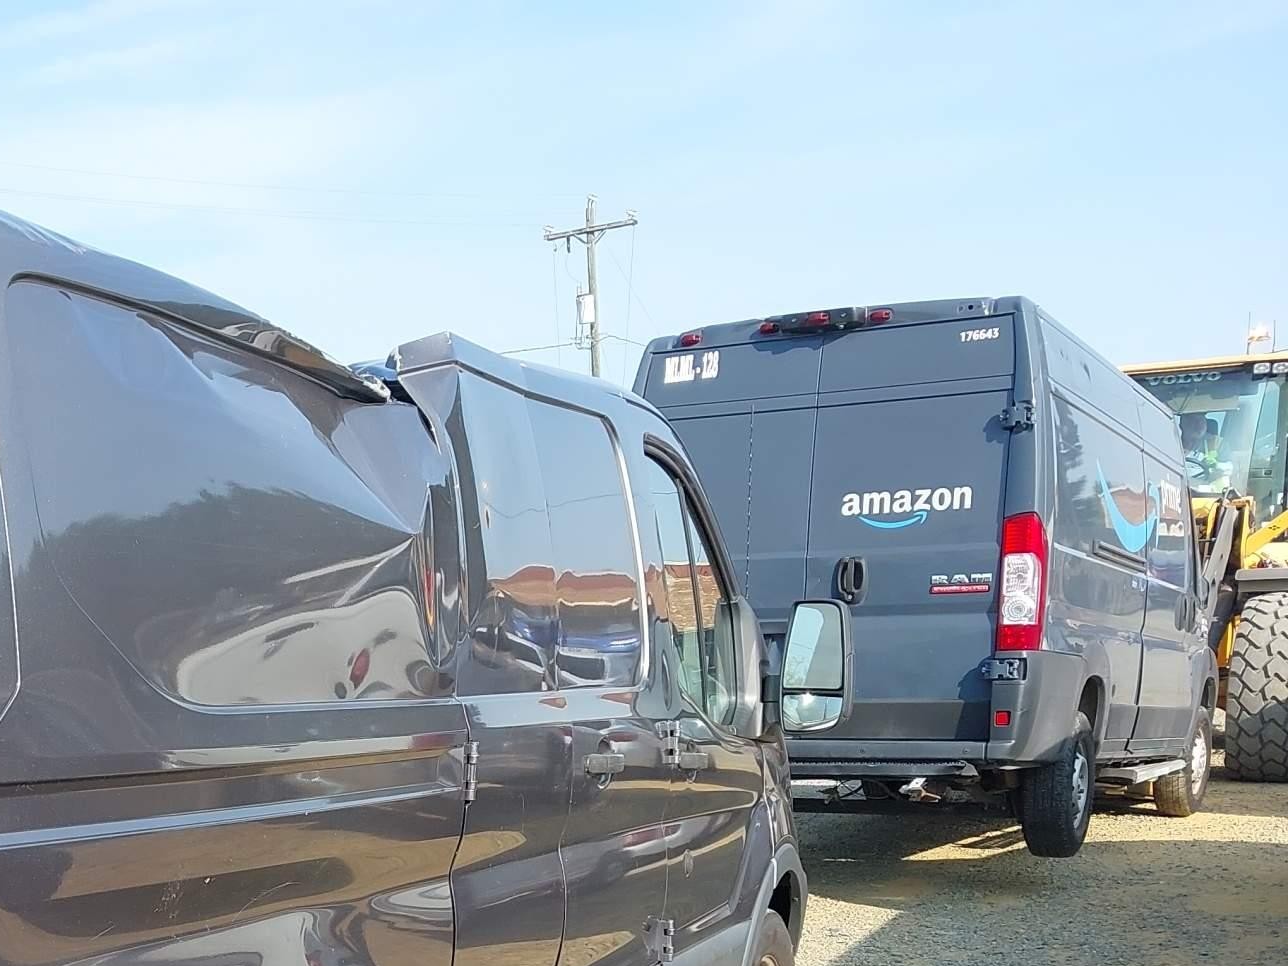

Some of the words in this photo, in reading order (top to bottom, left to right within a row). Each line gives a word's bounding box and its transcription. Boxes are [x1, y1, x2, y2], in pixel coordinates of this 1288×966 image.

[960, 327, 999, 342] 176643
[1145, 371, 1222, 386] VOLVO
[841, 485, 973, 516] amazon
[931, 573, 993, 584] RAM
